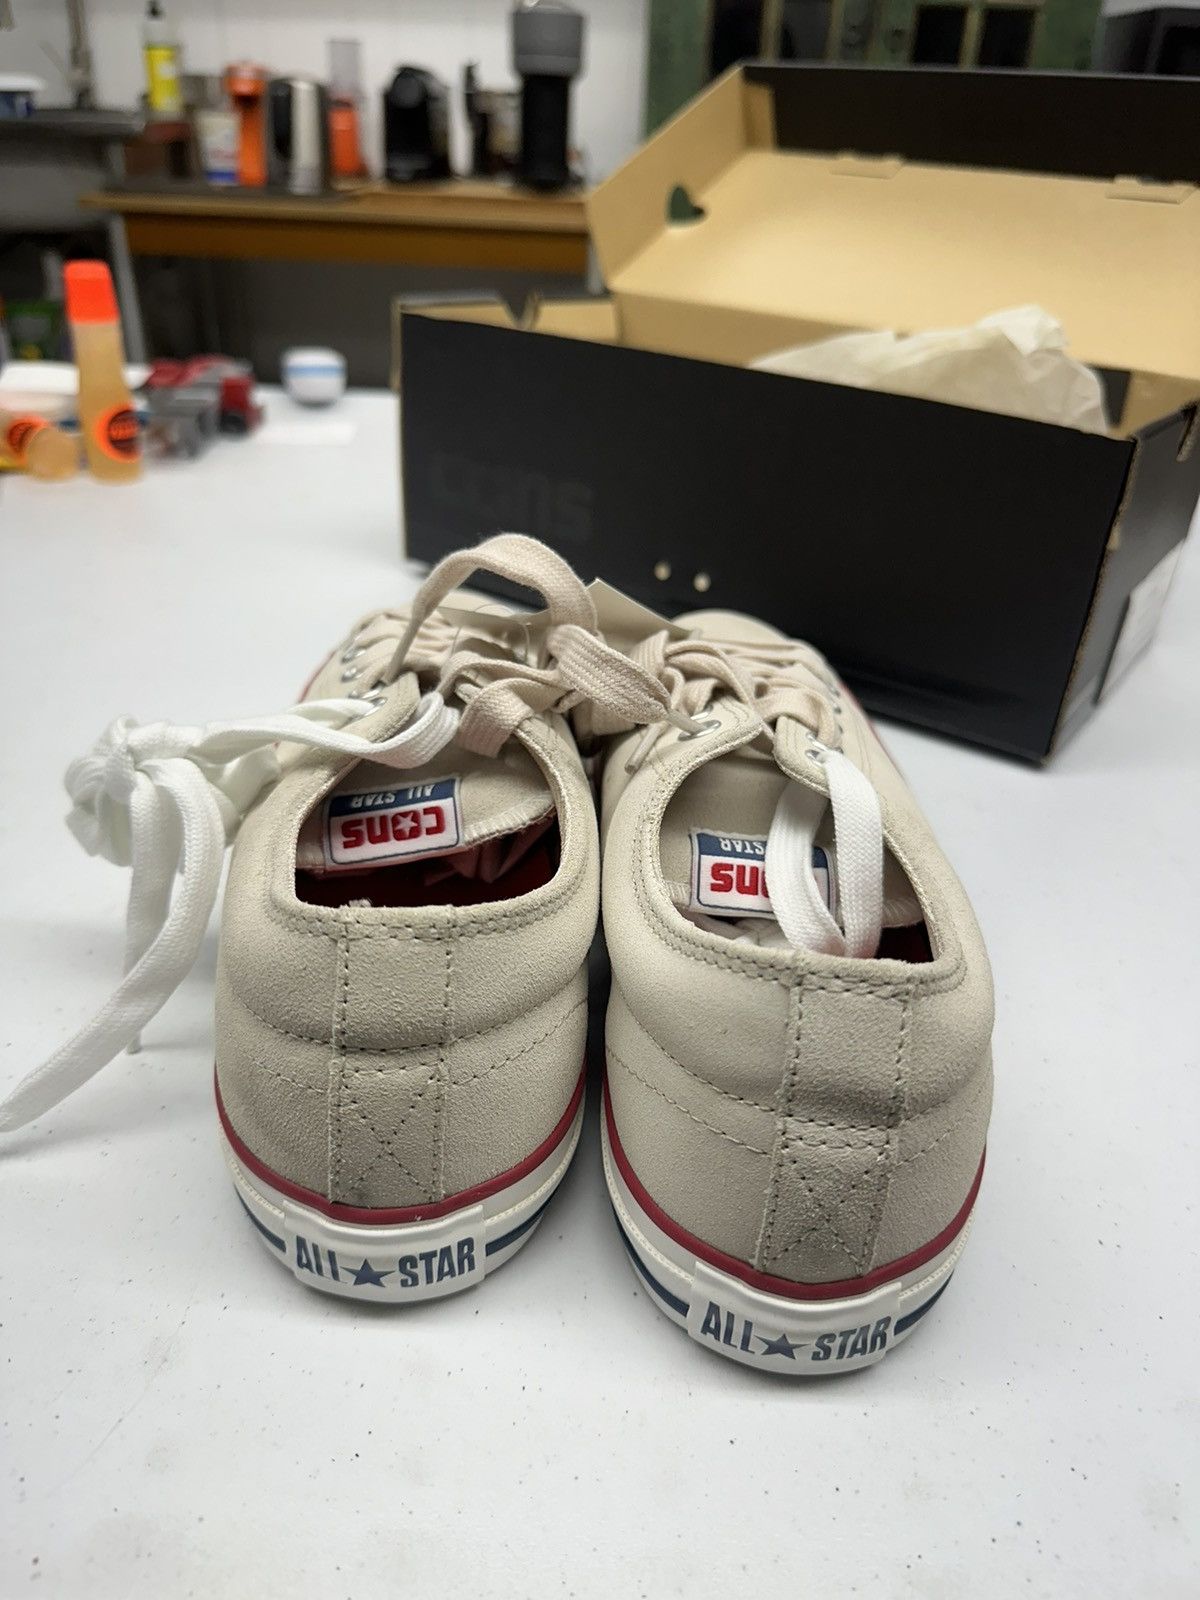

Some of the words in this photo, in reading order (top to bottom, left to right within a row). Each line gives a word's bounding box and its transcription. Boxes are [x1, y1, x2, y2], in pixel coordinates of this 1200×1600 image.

[350, 789, 396, 808] STAR
[406, 784, 434, 799] ALL
[719, 837, 765, 855] STAR
[296, 1235, 347, 1283] ALL
[398, 1237, 475, 1287] STAR
[701, 1301, 755, 1354] ALL
[811, 1316, 891, 1360] STAR
